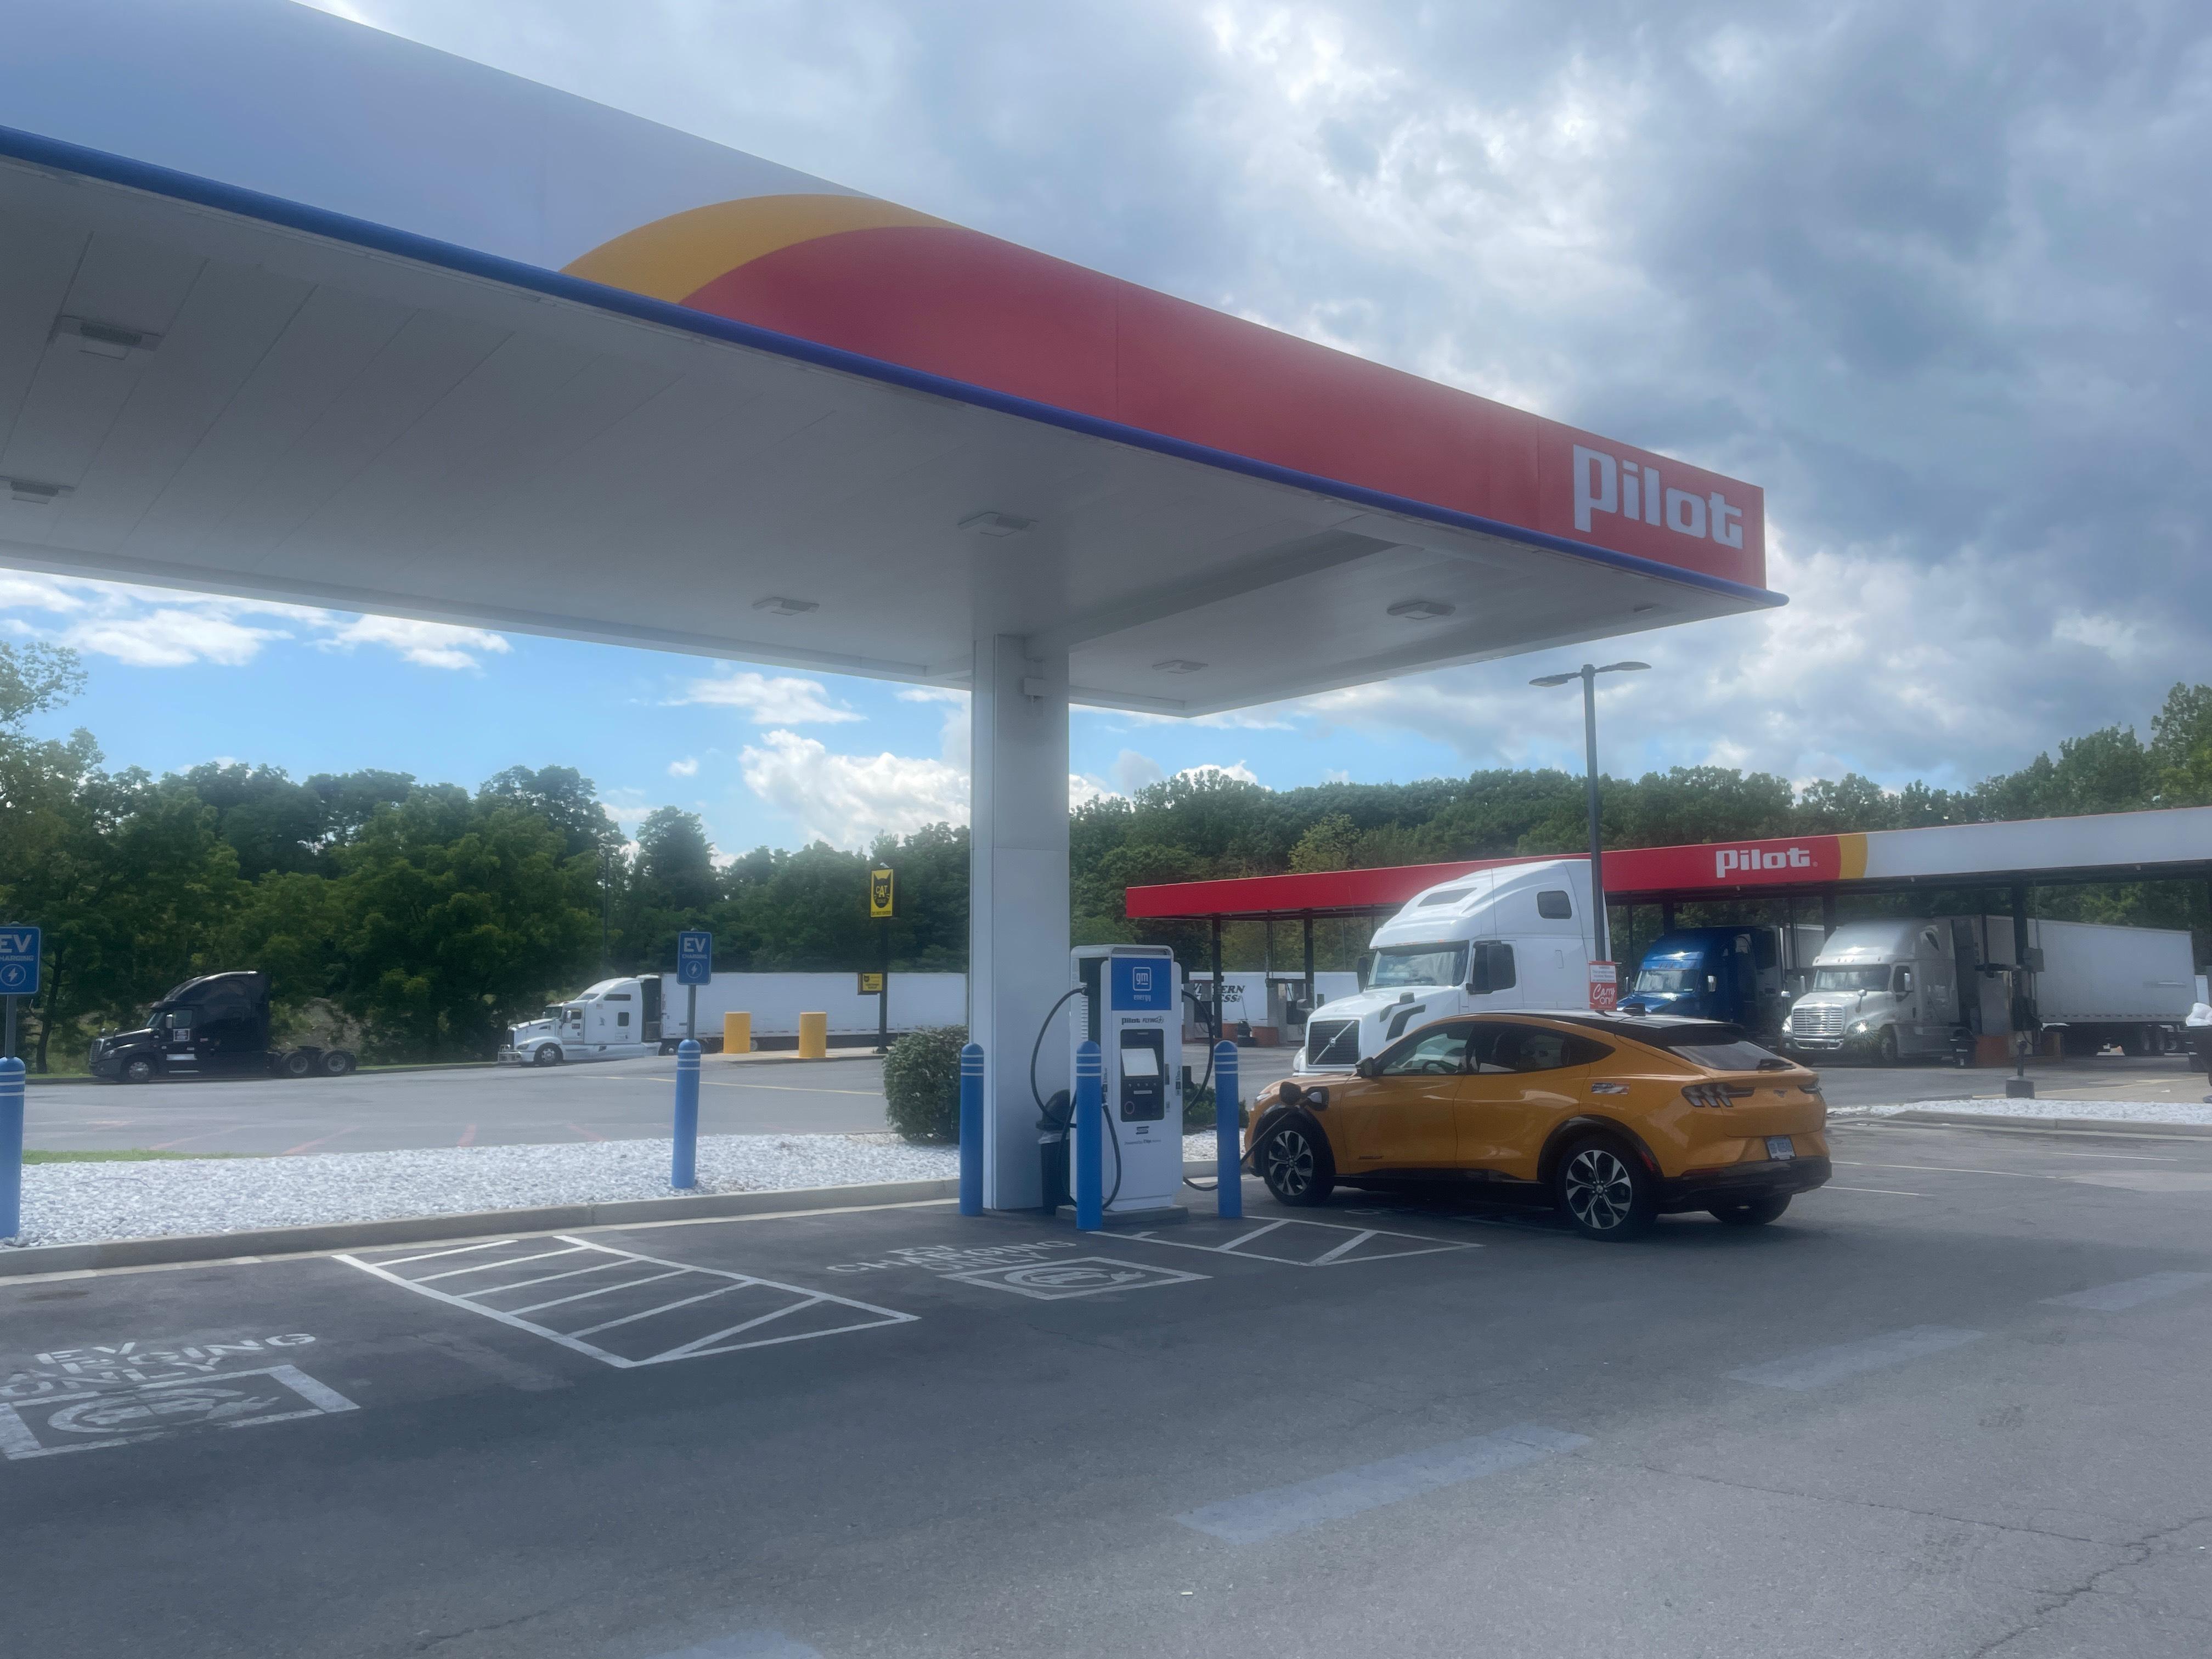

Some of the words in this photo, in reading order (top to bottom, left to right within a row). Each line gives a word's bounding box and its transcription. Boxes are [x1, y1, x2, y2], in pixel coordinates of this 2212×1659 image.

[0, 934, 32, 953] EV
[684, 937, 706, 952] EV
[1136, 973, 1148, 985] gm
[1593, 984, 1616, 1003] Carry
